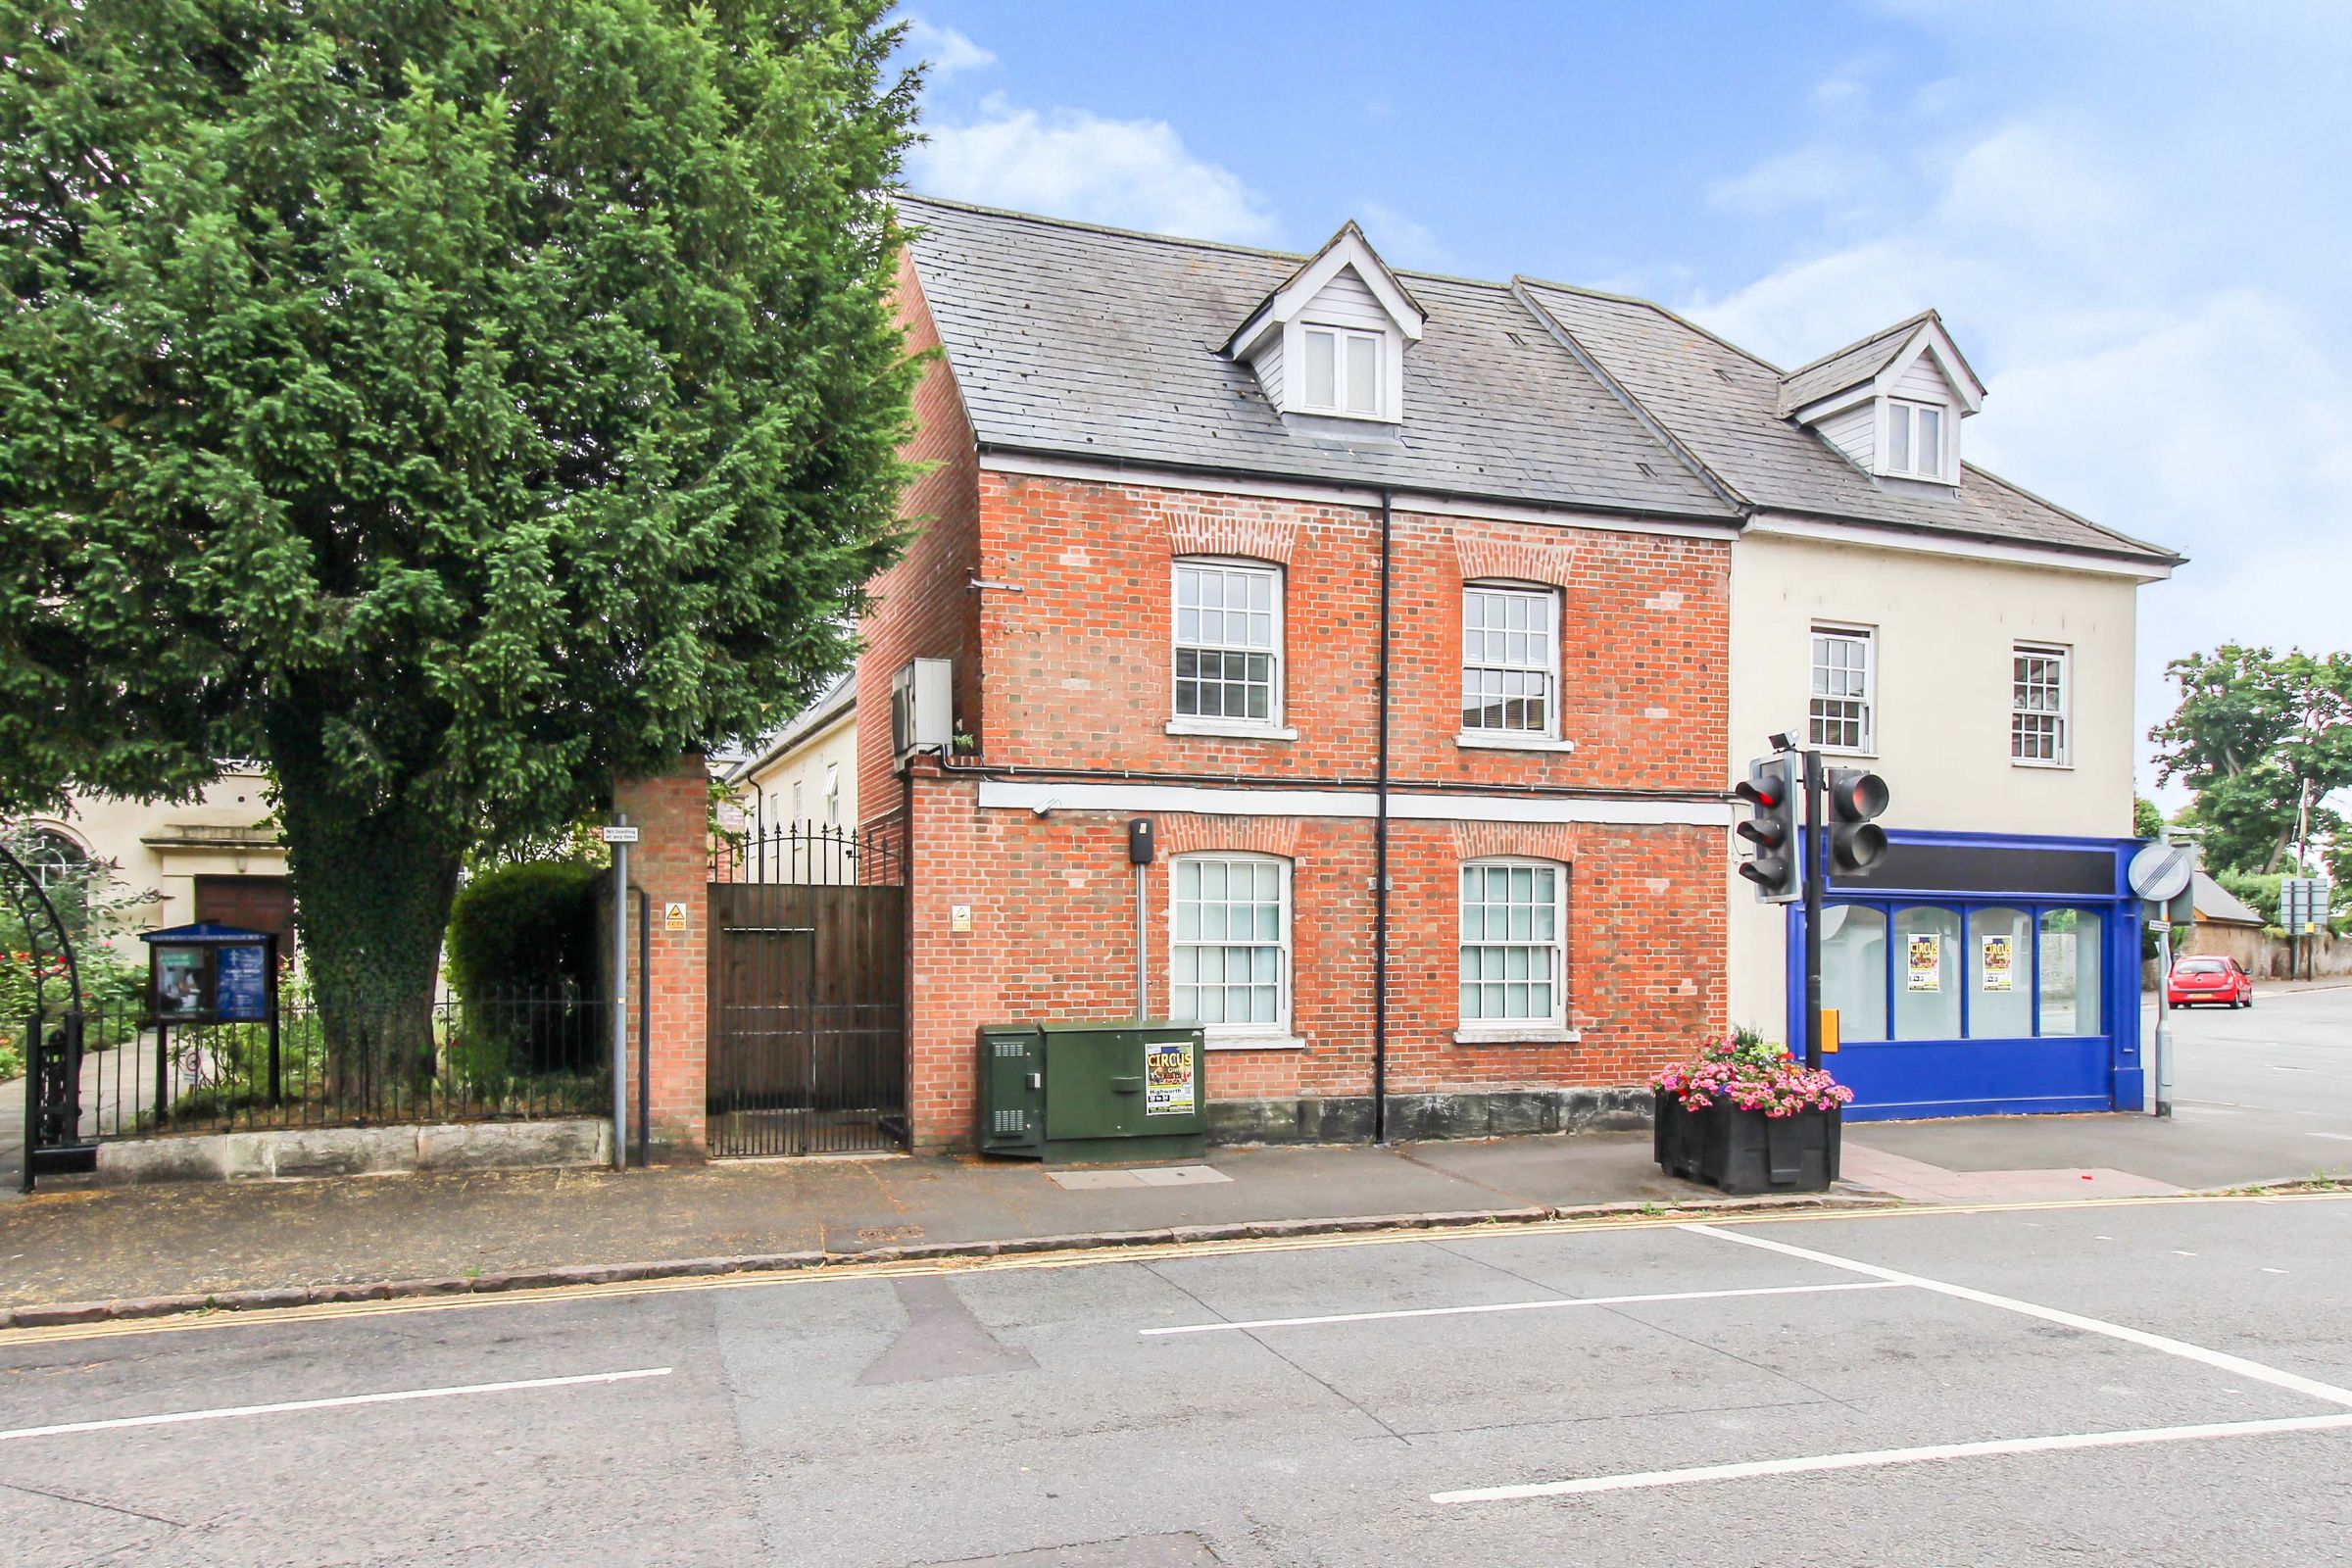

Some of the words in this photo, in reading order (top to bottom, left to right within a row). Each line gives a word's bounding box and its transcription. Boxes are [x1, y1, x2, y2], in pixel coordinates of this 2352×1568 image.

[1910, 942, 1938, 954] CIRCUS
[1984, 943, 2011, 955] CIRCUS
[1148, 1053, 1192, 1067] CIRCUS
